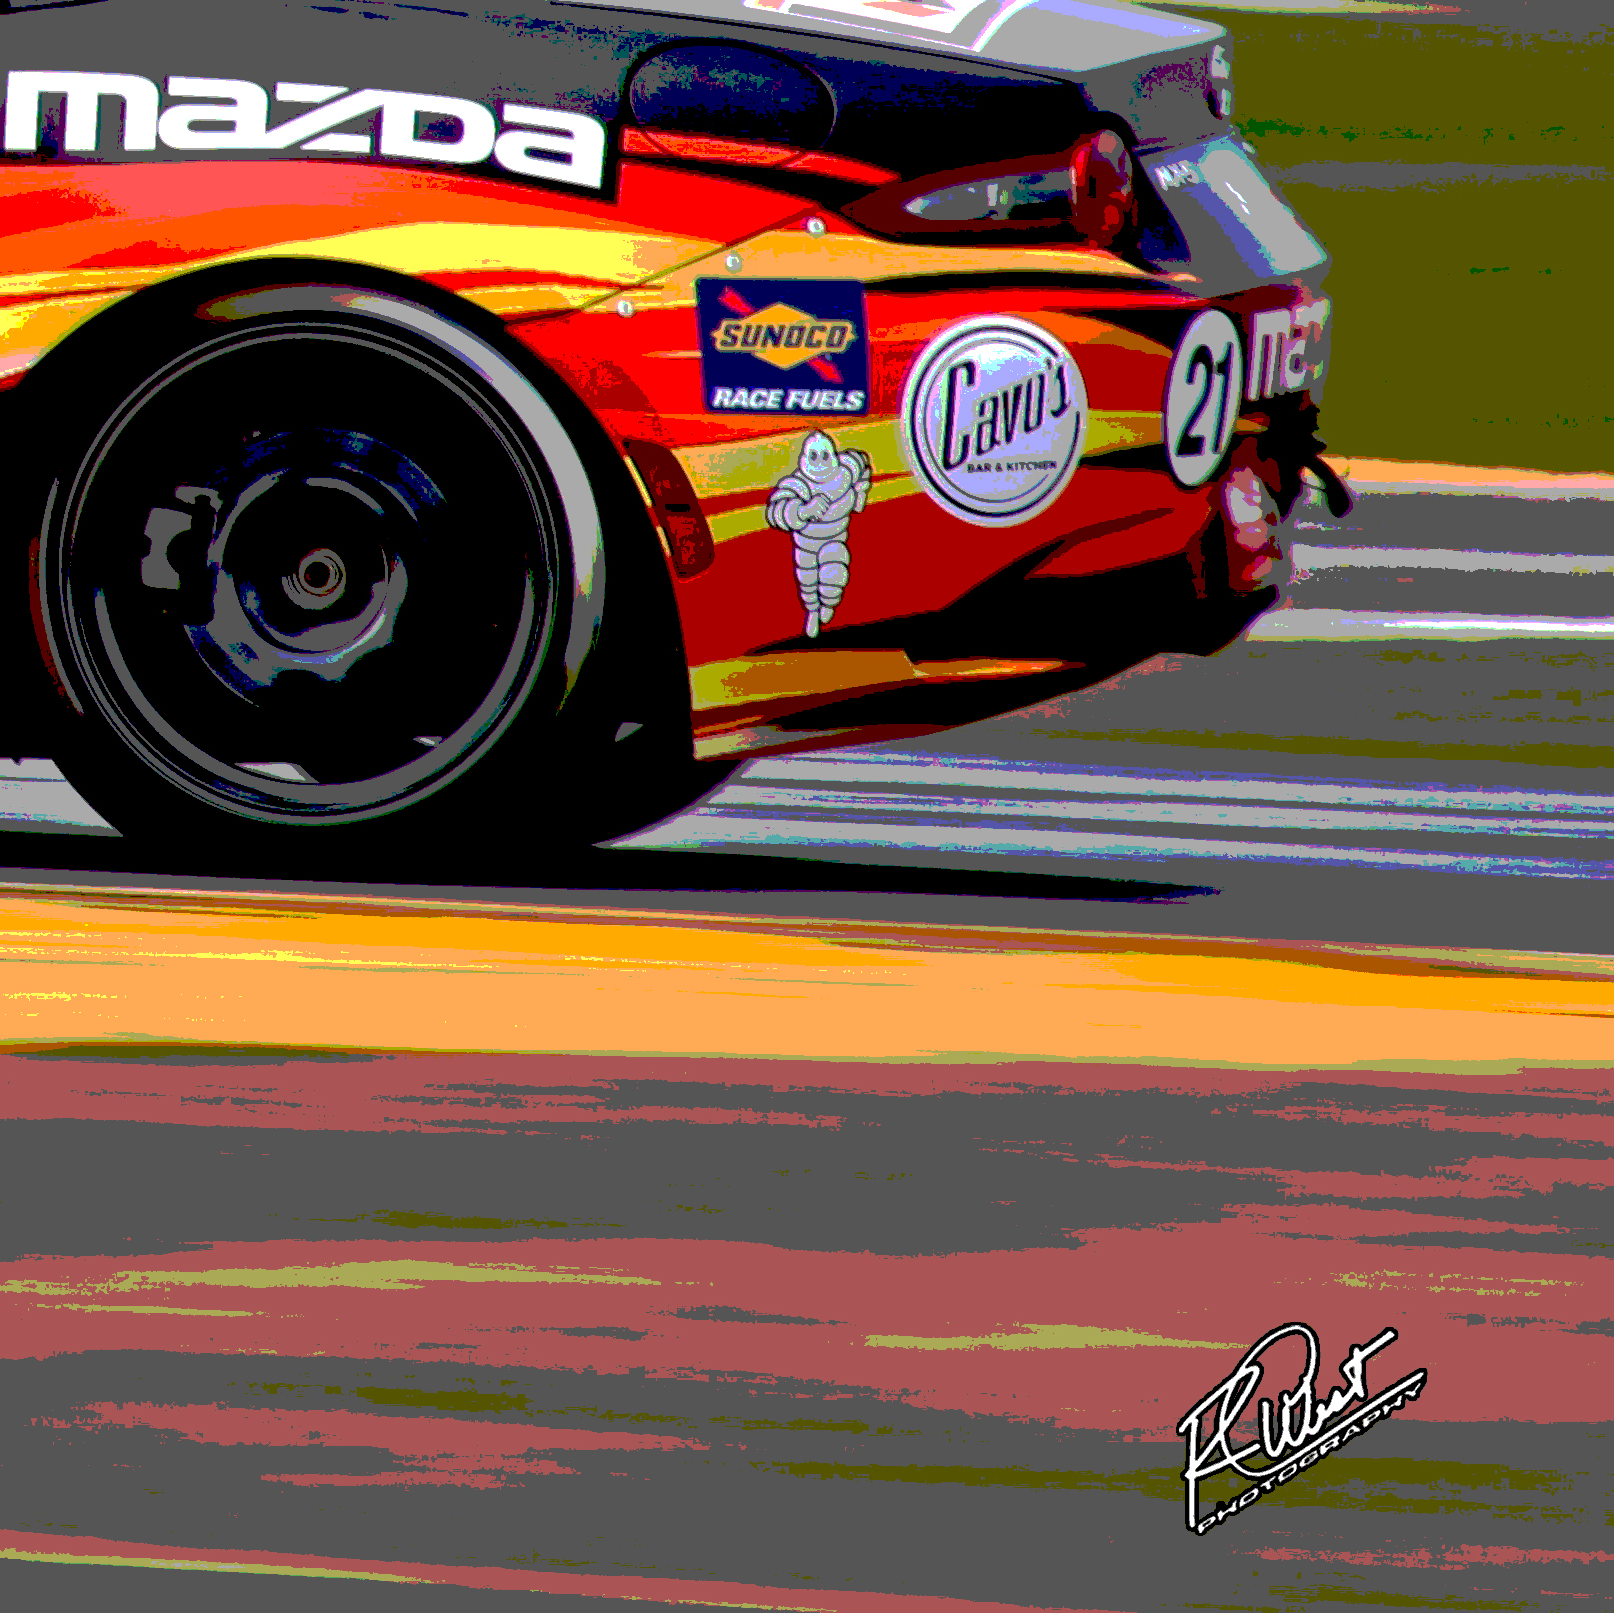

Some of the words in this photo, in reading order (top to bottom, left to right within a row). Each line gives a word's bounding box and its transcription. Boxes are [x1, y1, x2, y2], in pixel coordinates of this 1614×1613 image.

[720, 323, 849, 348] SUNOCO
[711, 386, 785, 409] RACE
[784, 388, 866, 411] FUELS
[1174, 342, 1235, 459] 21
